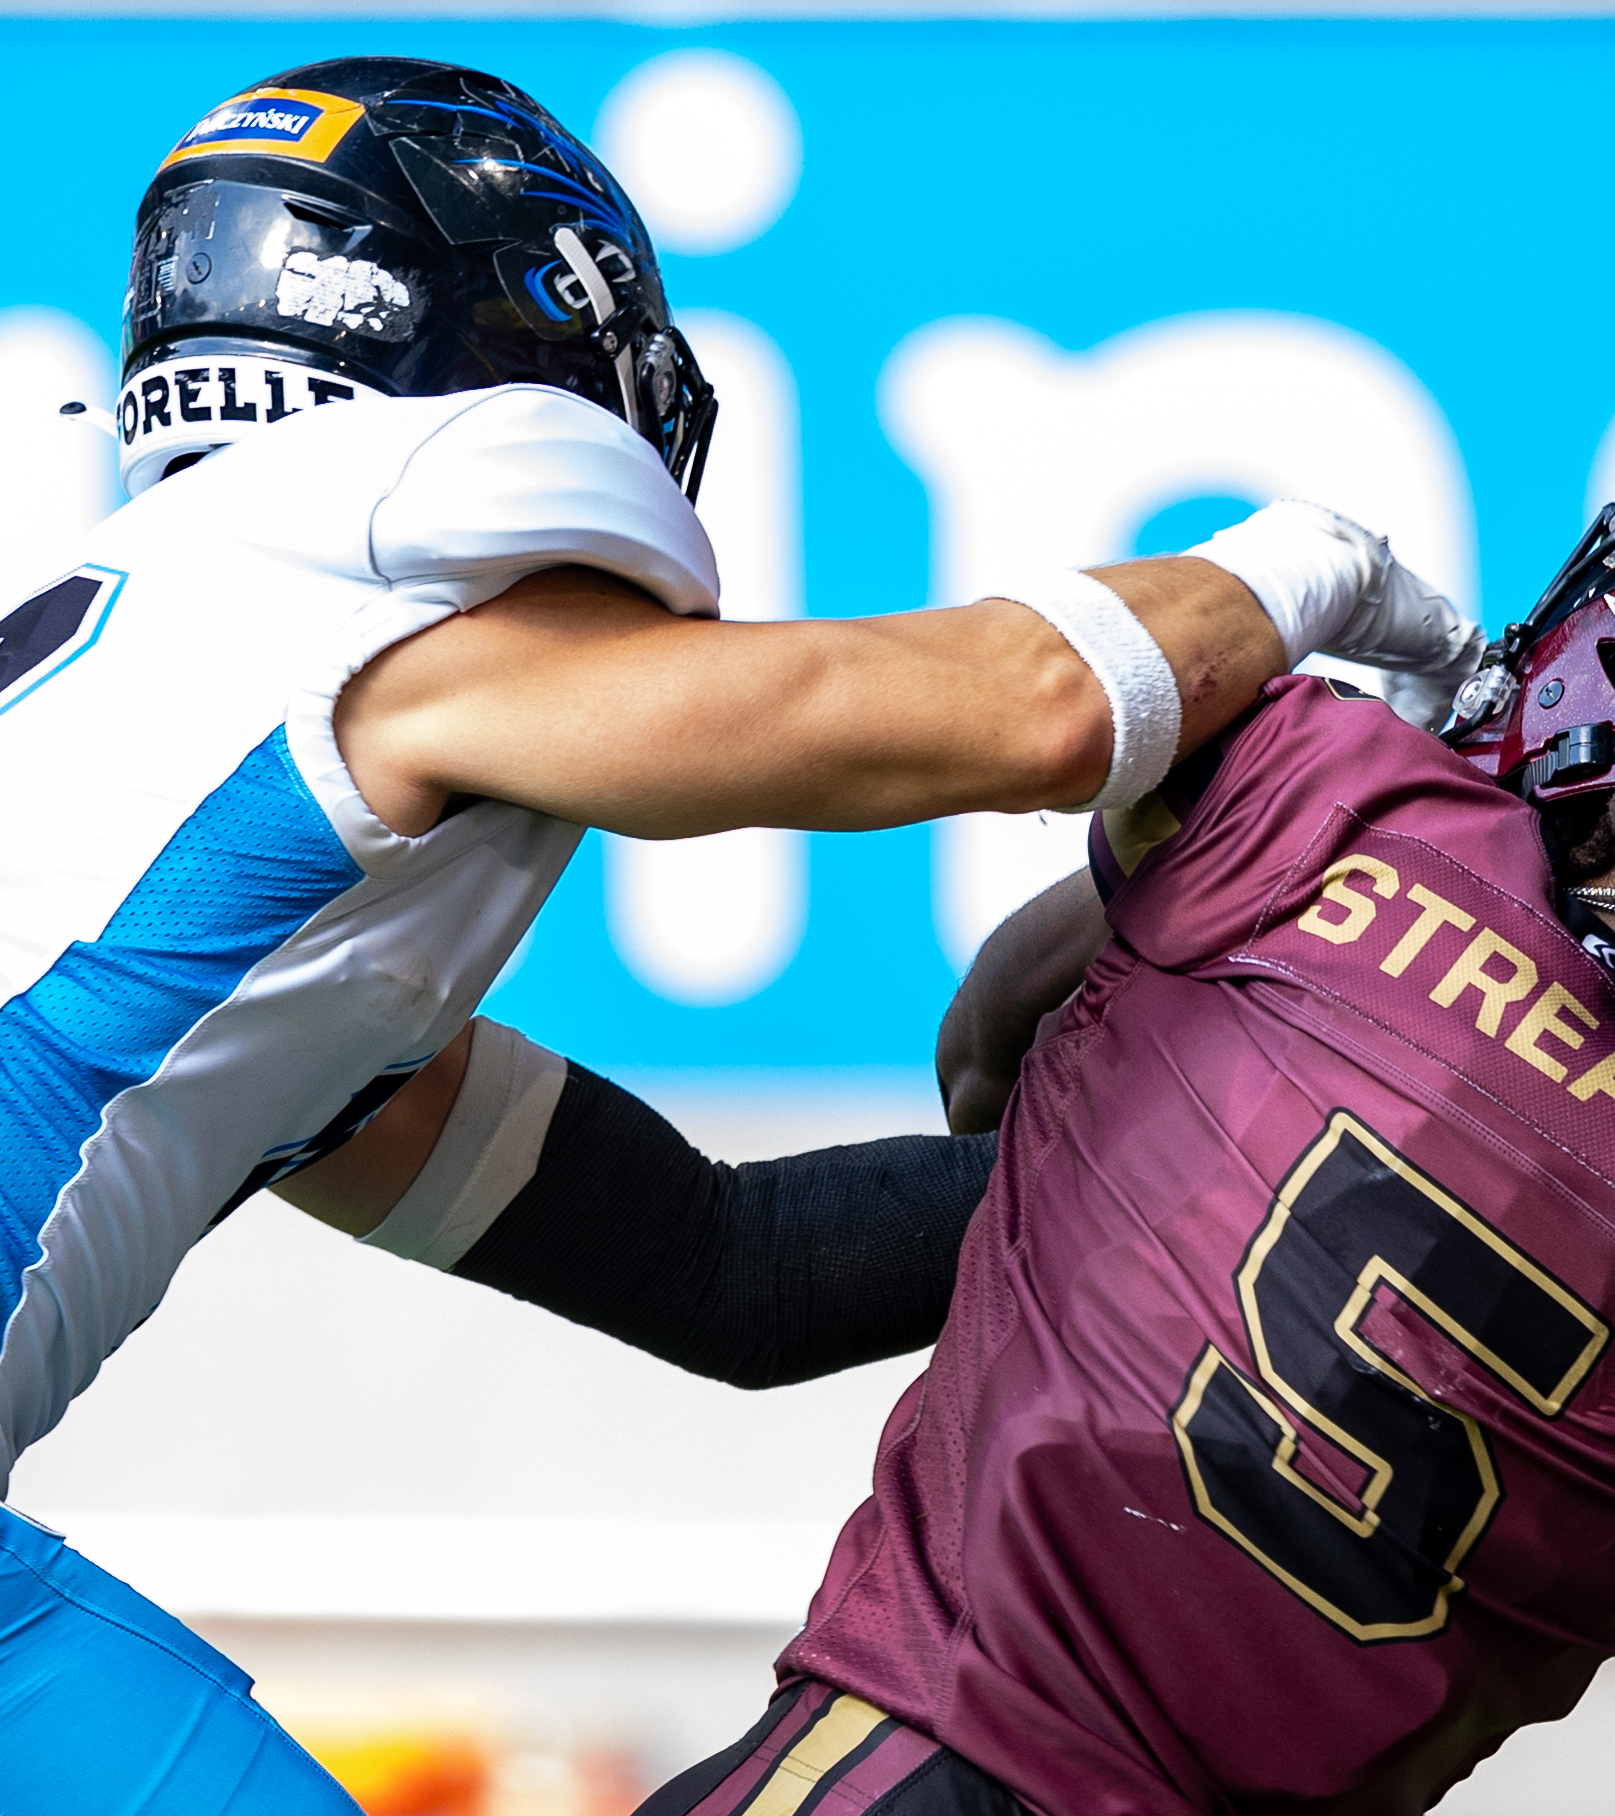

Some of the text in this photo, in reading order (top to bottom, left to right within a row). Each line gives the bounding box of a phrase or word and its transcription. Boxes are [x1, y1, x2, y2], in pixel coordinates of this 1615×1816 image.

[185, 108, 310, 141] CZYŃSKI
[117, 367, 354, 445] ORELL
[1169, 1107, 1614, 1646] 5
